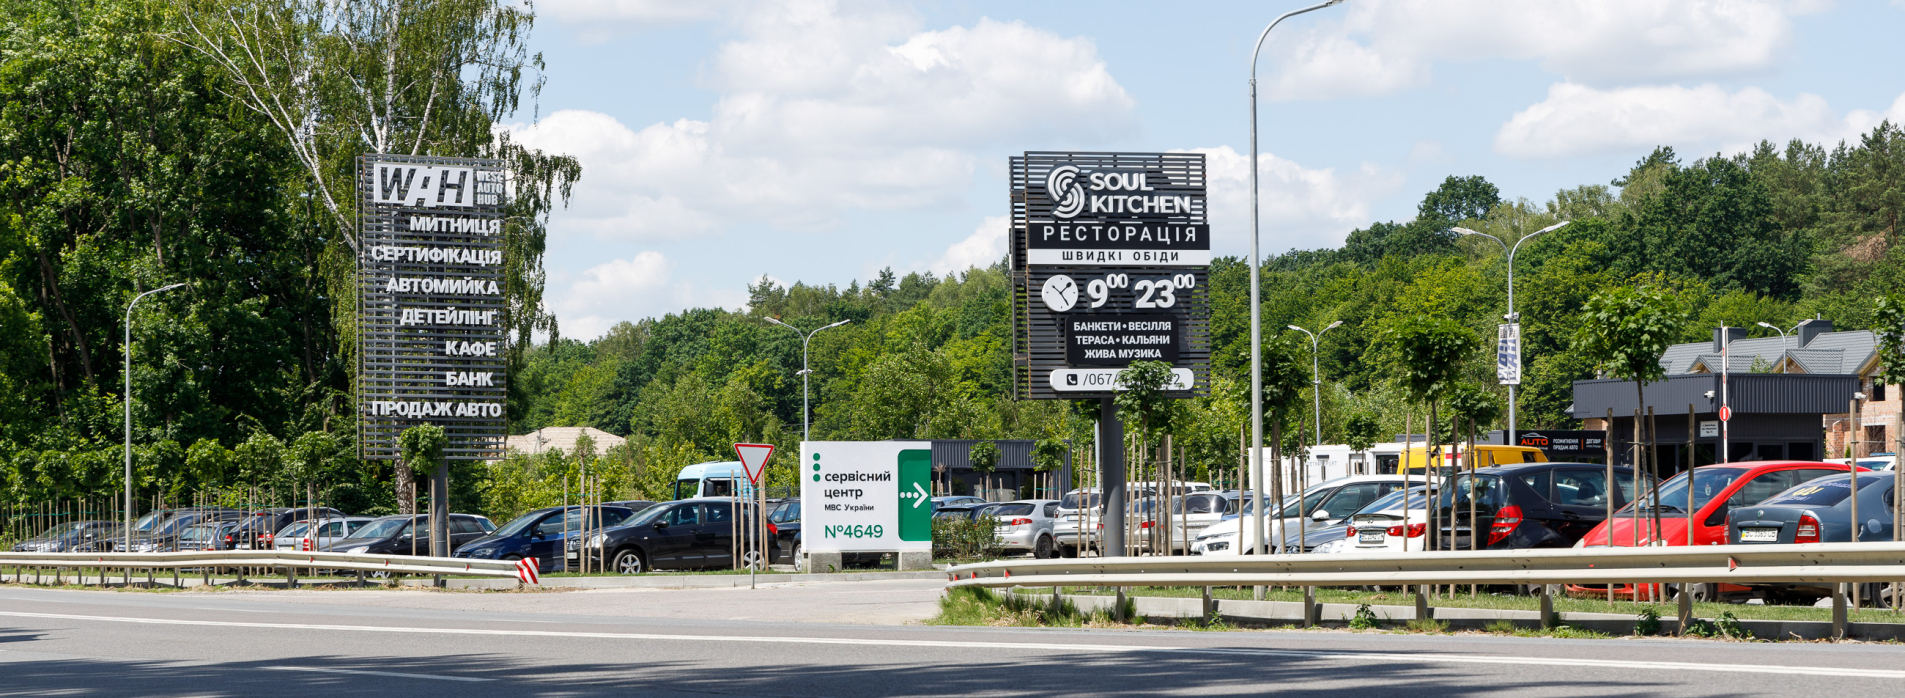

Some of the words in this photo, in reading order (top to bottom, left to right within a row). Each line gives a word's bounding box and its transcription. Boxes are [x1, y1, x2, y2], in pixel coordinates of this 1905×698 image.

[477, 171, 503, 182] WEST
[1090, 173, 1154, 191] SOUL
[374, 164, 473, 208] WAH
[477, 182, 503, 194] AUTO
[477, 194, 498, 205] HUB
[1091, 195, 1191, 214] KITCHEN
[410, 216, 500, 235] МИТНИЦЯ
[1043, 226, 1196, 244] РЕСТОРАЦІЯ
[372, 245, 501, 265] СЕРТИФІКАЦІЯ
[1062, 251, 1122, 262] ШВИДКІ
[1133, 251, 1179, 262] ОБІДИ
[386, 277, 499, 294] АВТОМИЙКА
[1073, 321, 1121, 331] БАНКЕТИ
[1128, 321, 1171, 331] ВЕСІЛЛЯ
[1076, 335, 1115, 345] ТЕРАСА
[1122, 335, 1170, 345] КАЛЬЯНИ
[446, 340, 497, 357] КАФЕ
[1084, 348, 1117, 359] ЖИВА
[1118, 348, 1162, 359] МУЗИКА
[446, 371, 493, 387] БАНК
[372, 400, 452, 418] ПРОДАЖ
[455, 402, 501, 417] АВТО
[1521, 438, 1548, 446] AUTO
[824, 470, 891, 484] сервісний
[824, 488, 863, 499] центр
[844, 504, 874, 512] України
